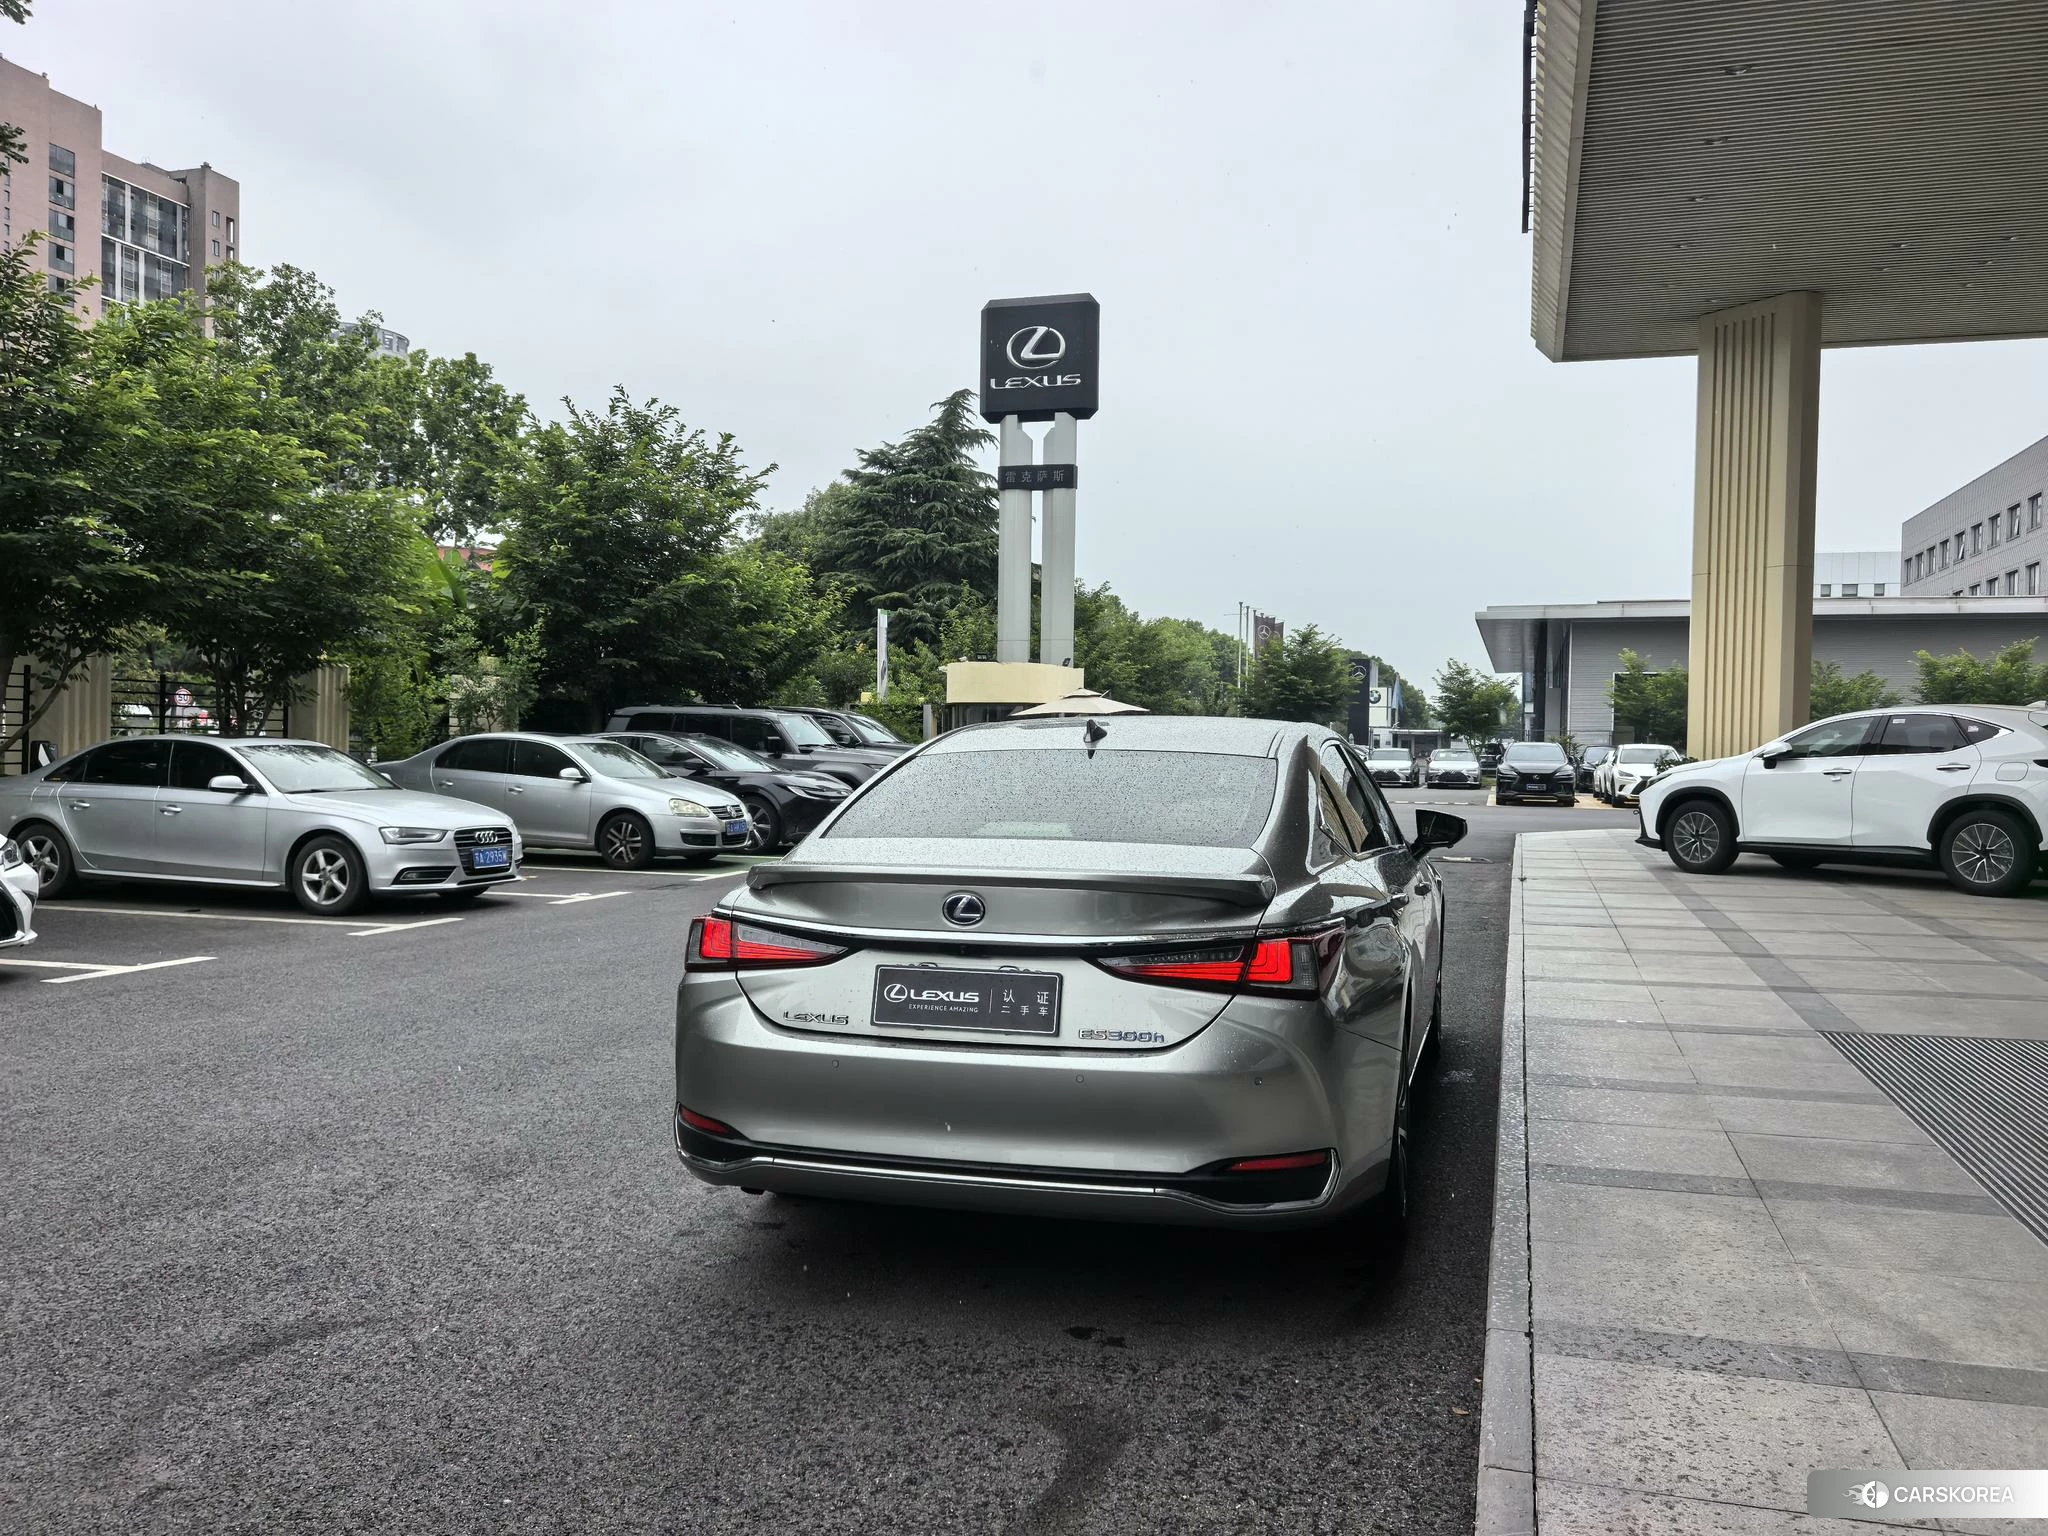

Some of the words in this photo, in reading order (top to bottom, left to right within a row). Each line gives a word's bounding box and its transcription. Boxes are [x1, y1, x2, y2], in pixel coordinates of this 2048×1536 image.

[990, 374, 1081, 389] LEXUS
[1005, 469, 1065, 483] 雷克萨斯
[910, 989, 979, 1003] LEXUS
[909, 1003, 947, 1012] EXPERIENCE
[949, 1004, 979, 1013] AMAZING
[783, 1011, 849, 1025] LEXUS
